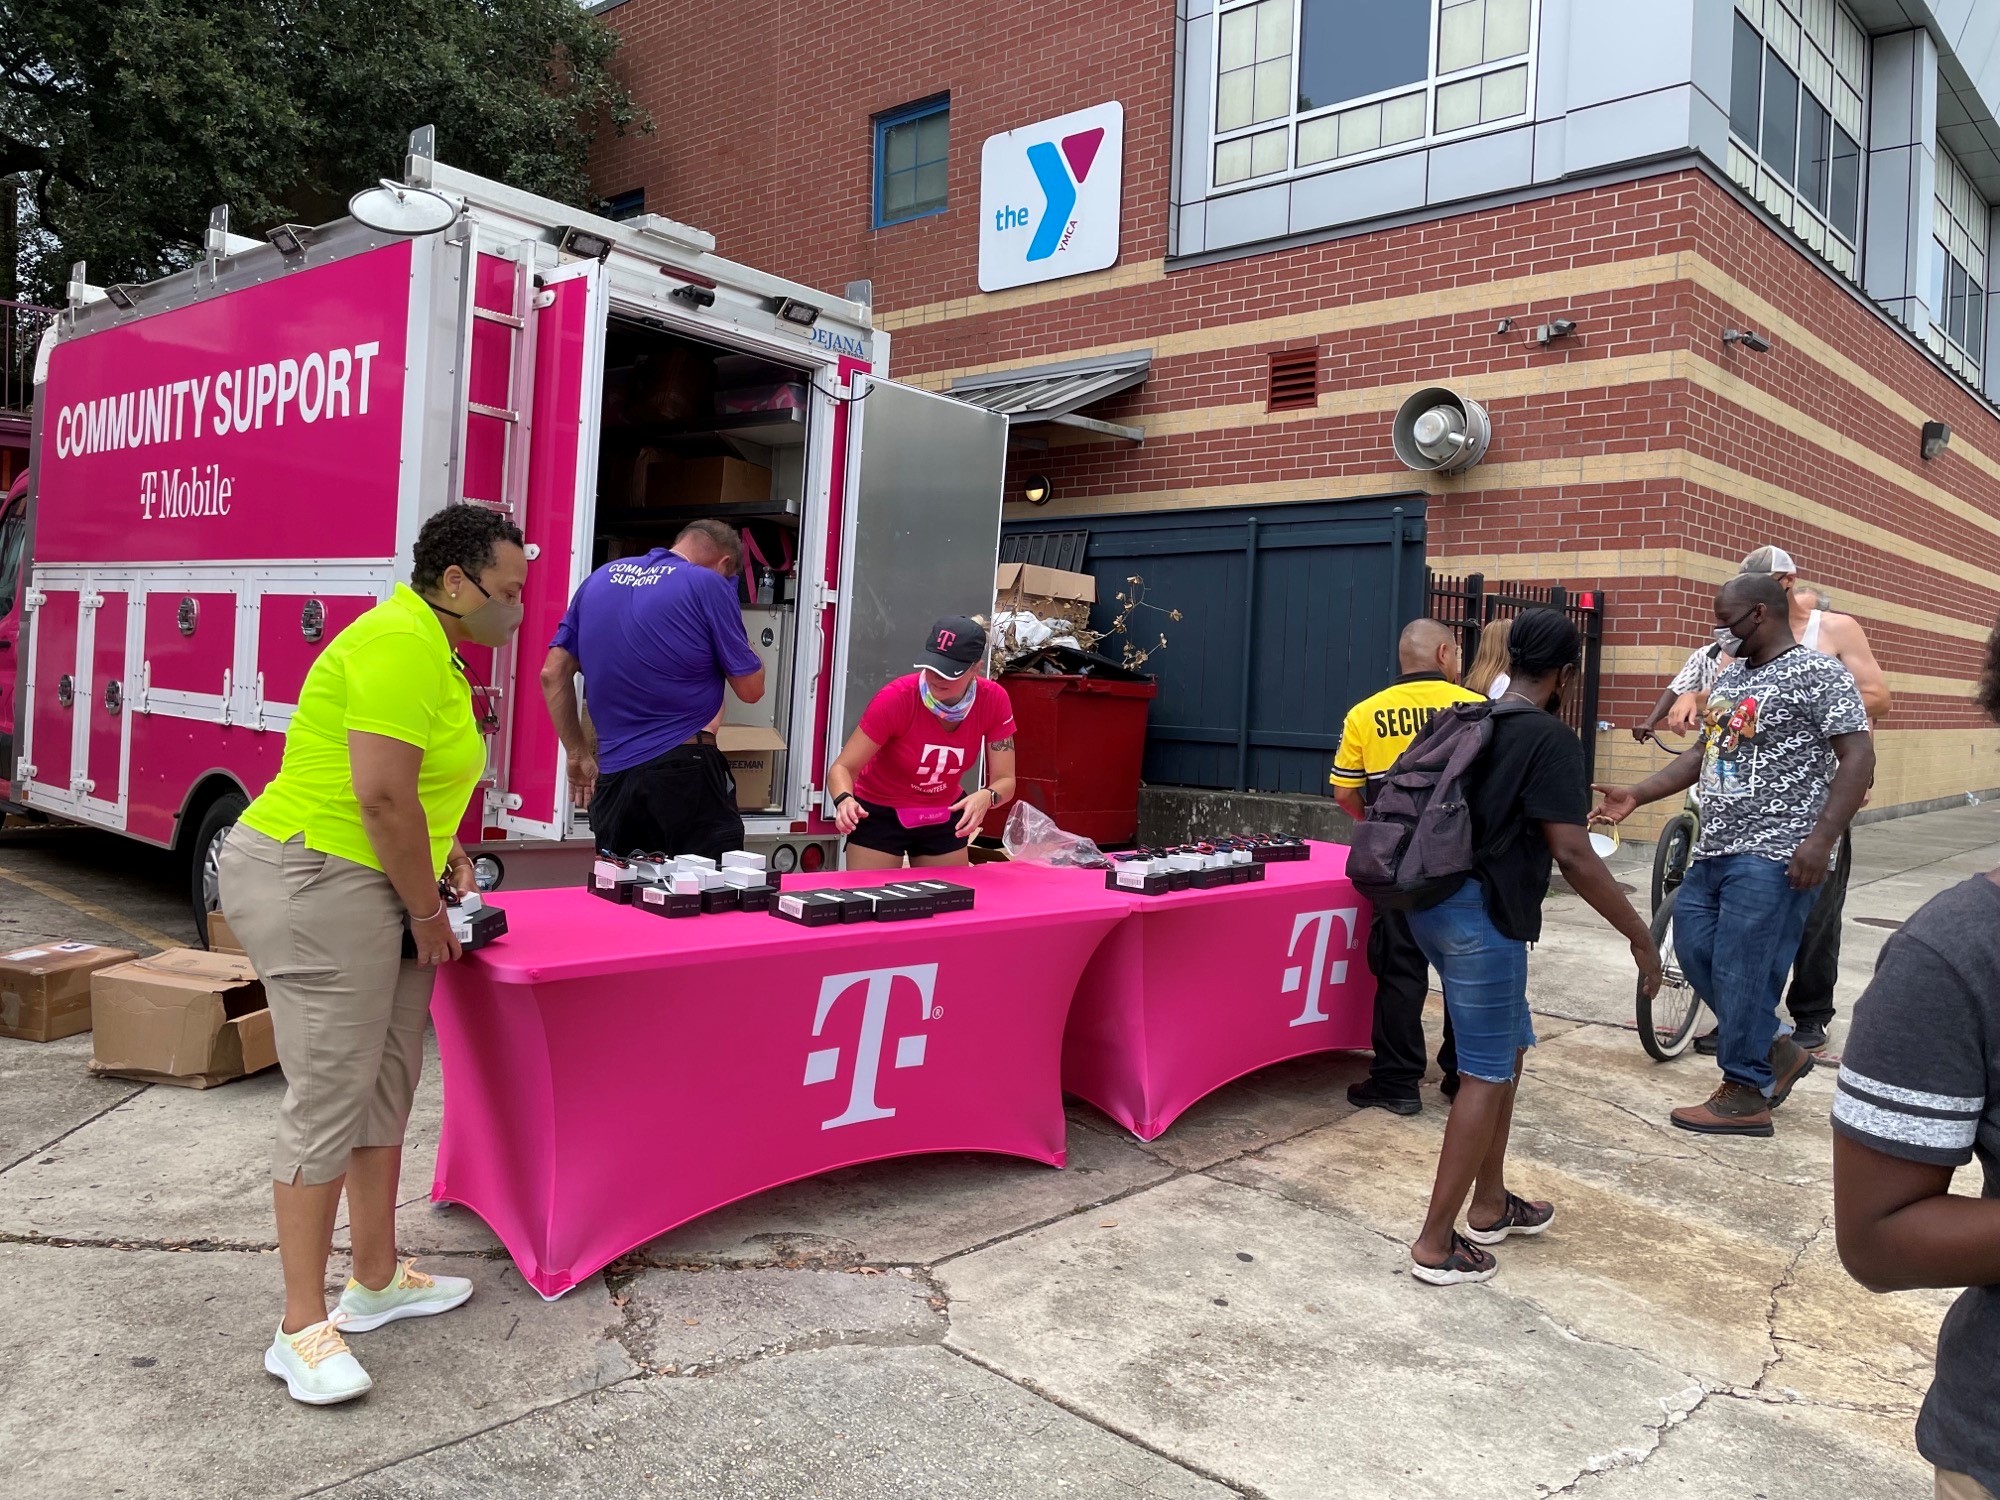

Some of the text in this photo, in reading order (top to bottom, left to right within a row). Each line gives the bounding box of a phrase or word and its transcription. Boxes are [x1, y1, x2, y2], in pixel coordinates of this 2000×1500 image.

[996, 205, 1029, 231] the
[1058, 220, 1078, 251] YMCA
[56, 341, 380, 460] COMMUNITY SUPPORT
[608, 563, 677, 577] COMMUNITY
[609, 573, 662, 587] SUPPORT
[1374, 705, 1452, 738] SECU
[728, 760, 764, 769] REEMAN
[916, 743, 965, 786] T
[910, 782, 948, 794] VOLUNTEER
[1281, 907, 1358, 1028] T
[803, 962, 939, 1131] T
